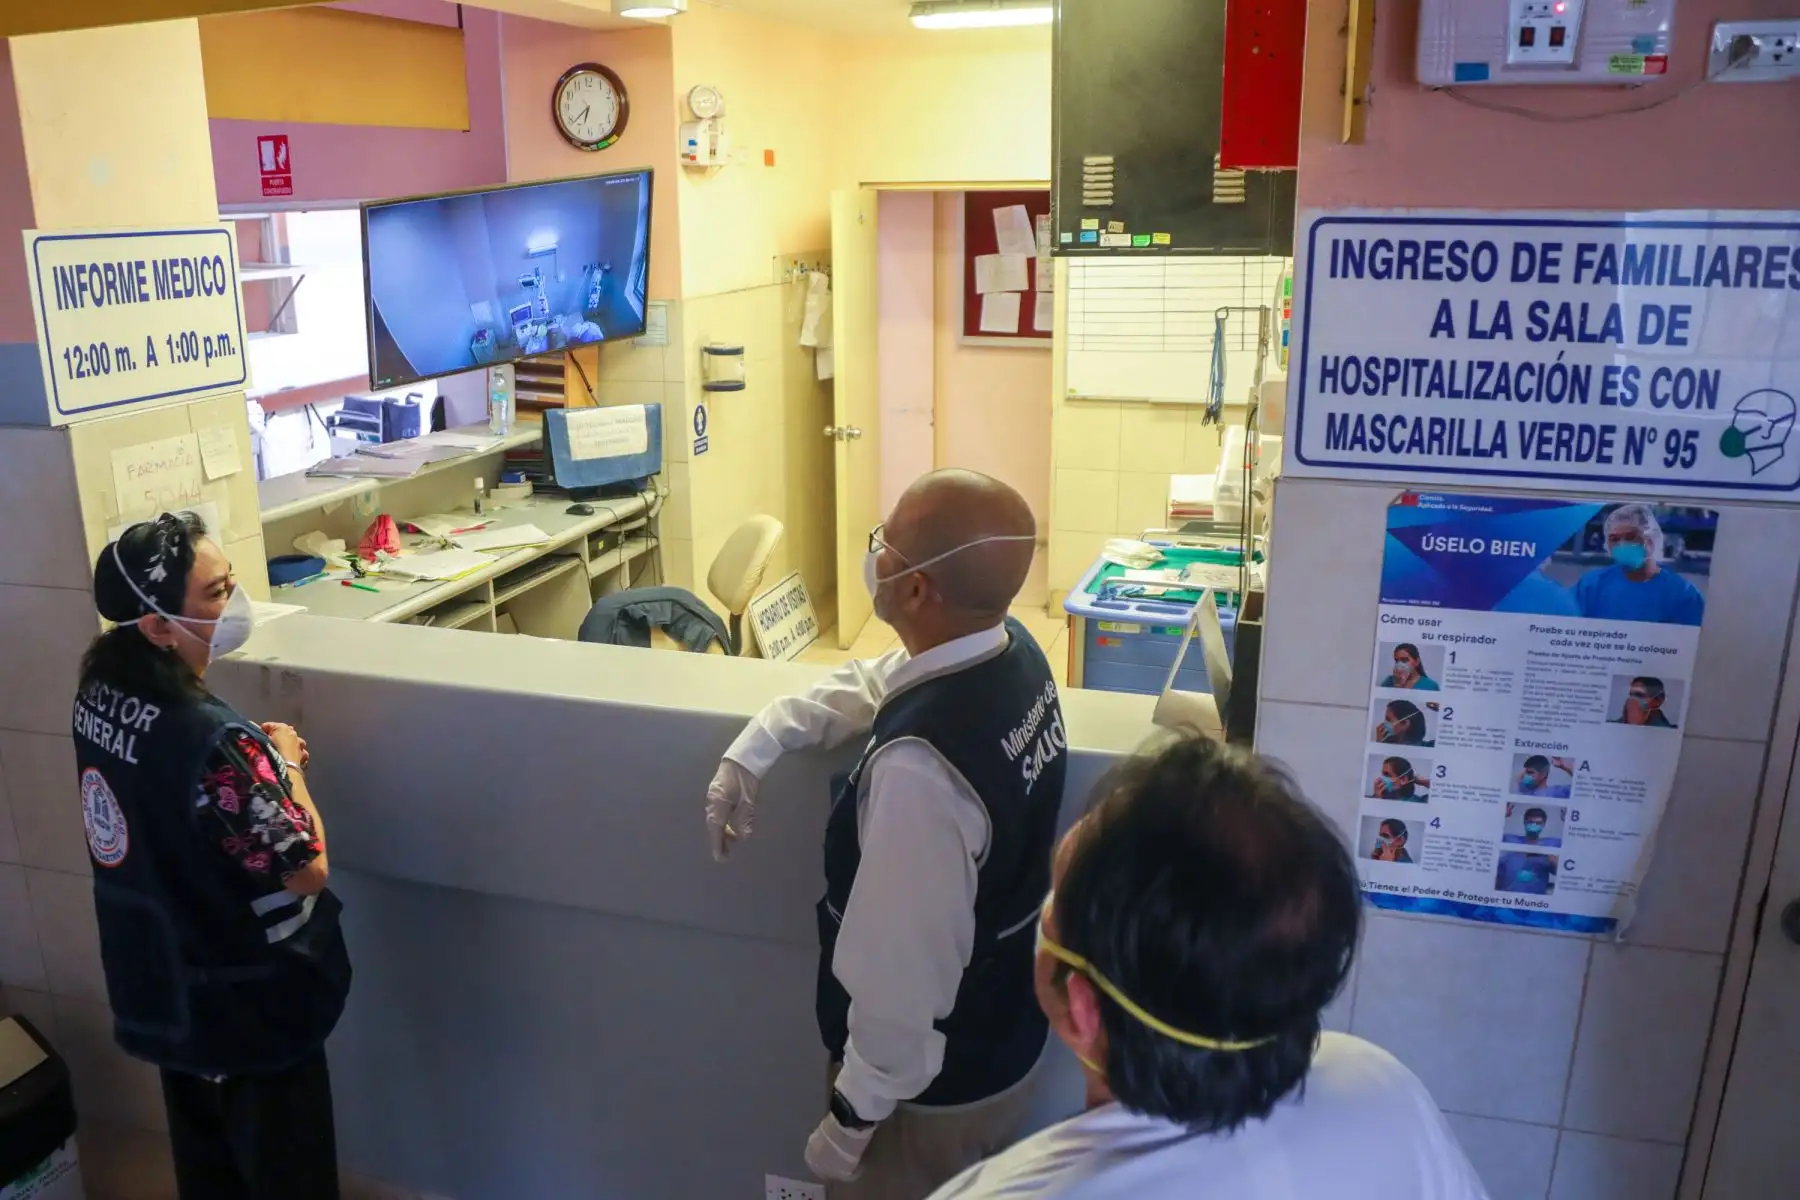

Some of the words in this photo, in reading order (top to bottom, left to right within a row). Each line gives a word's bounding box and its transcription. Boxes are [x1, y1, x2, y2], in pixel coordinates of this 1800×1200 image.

[1330, 238, 1498, 283] INGRESO
[1510, 242, 1562, 283] DE
[53, 261, 150, 310] INFORME
[152, 255, 226, 300] MEDICO
[1429, 298, 1455, 338] A
[1468, 299, 1513, 340] LA
[1526, 300, 1624, 344] SALA
[1637, 304, 1691, 346] DE
[64, 342, 111, 380] 12:00
[115, 346, 137, 372] m.
[146, 335, 158, 368] A
[166, 331, 199, 364] 1:00
[203, 333, 236, 367] p.m.
[1320, 351, 1592, 404] HOSPITALIZACIÓN
[1601, 365, 1641, 407] ES
[1650, 367, 1721, 410] CON
[1325, 412, 1508, 459] MASCARILLA
[1519, 420, 1617, 464] VERDE
[1664, 428, 1699, 469] 95
[1421, 533, 1485, 554] ÚSELO
[1490, 540, 1536, 558] BIEN
[758, 601, 783, 631] HORARIO
[779, 595, 790, 616] DE
[1380, 613, 1415, 626] Cómo
[1418, 617, 1442, 627] usar
[1422, 632, 1434, 641] su
[1437, 633, 1497, 645] respirador
[1529, 624, 1562, 635] Pruebe
[1578, 628, 1628, 640] respirador
[1550, 638, 1572, 647] cada
[1594, 642, 1612, 650] que
[1627, 643, 1636, 651] lo
[1638, 645, 1678, 655] coloque
[1449, 651, 1457, 664] 1
[1000, 695, 1045, 761] Ministerio
[1044, 680, 1057, 704] de
[1443, 707, 1454, 720] 2
[74, 700, 139, 765] GENERAL
[1514, 738, 1569, 751] Extracción
[1435, 765, 1447, 778] 3
[1579, 760, 1590, 771] A
[1430, 817, 1441, 829] 4
[1571, 810, 1580, 822] B
[1563, 858, 1576, 871] C
[1368, 882, 1399, 892] Tienes
[1402, 885, 1411, 893] el
[1412, 886, 1440, 896] Poder
[1443, 889, 1455, 898] de
[1457, 891, 1499, 904] Proteger
[1502, 897, 1512, 905] tu
[1514, 898, 1549, 909] Mundo
